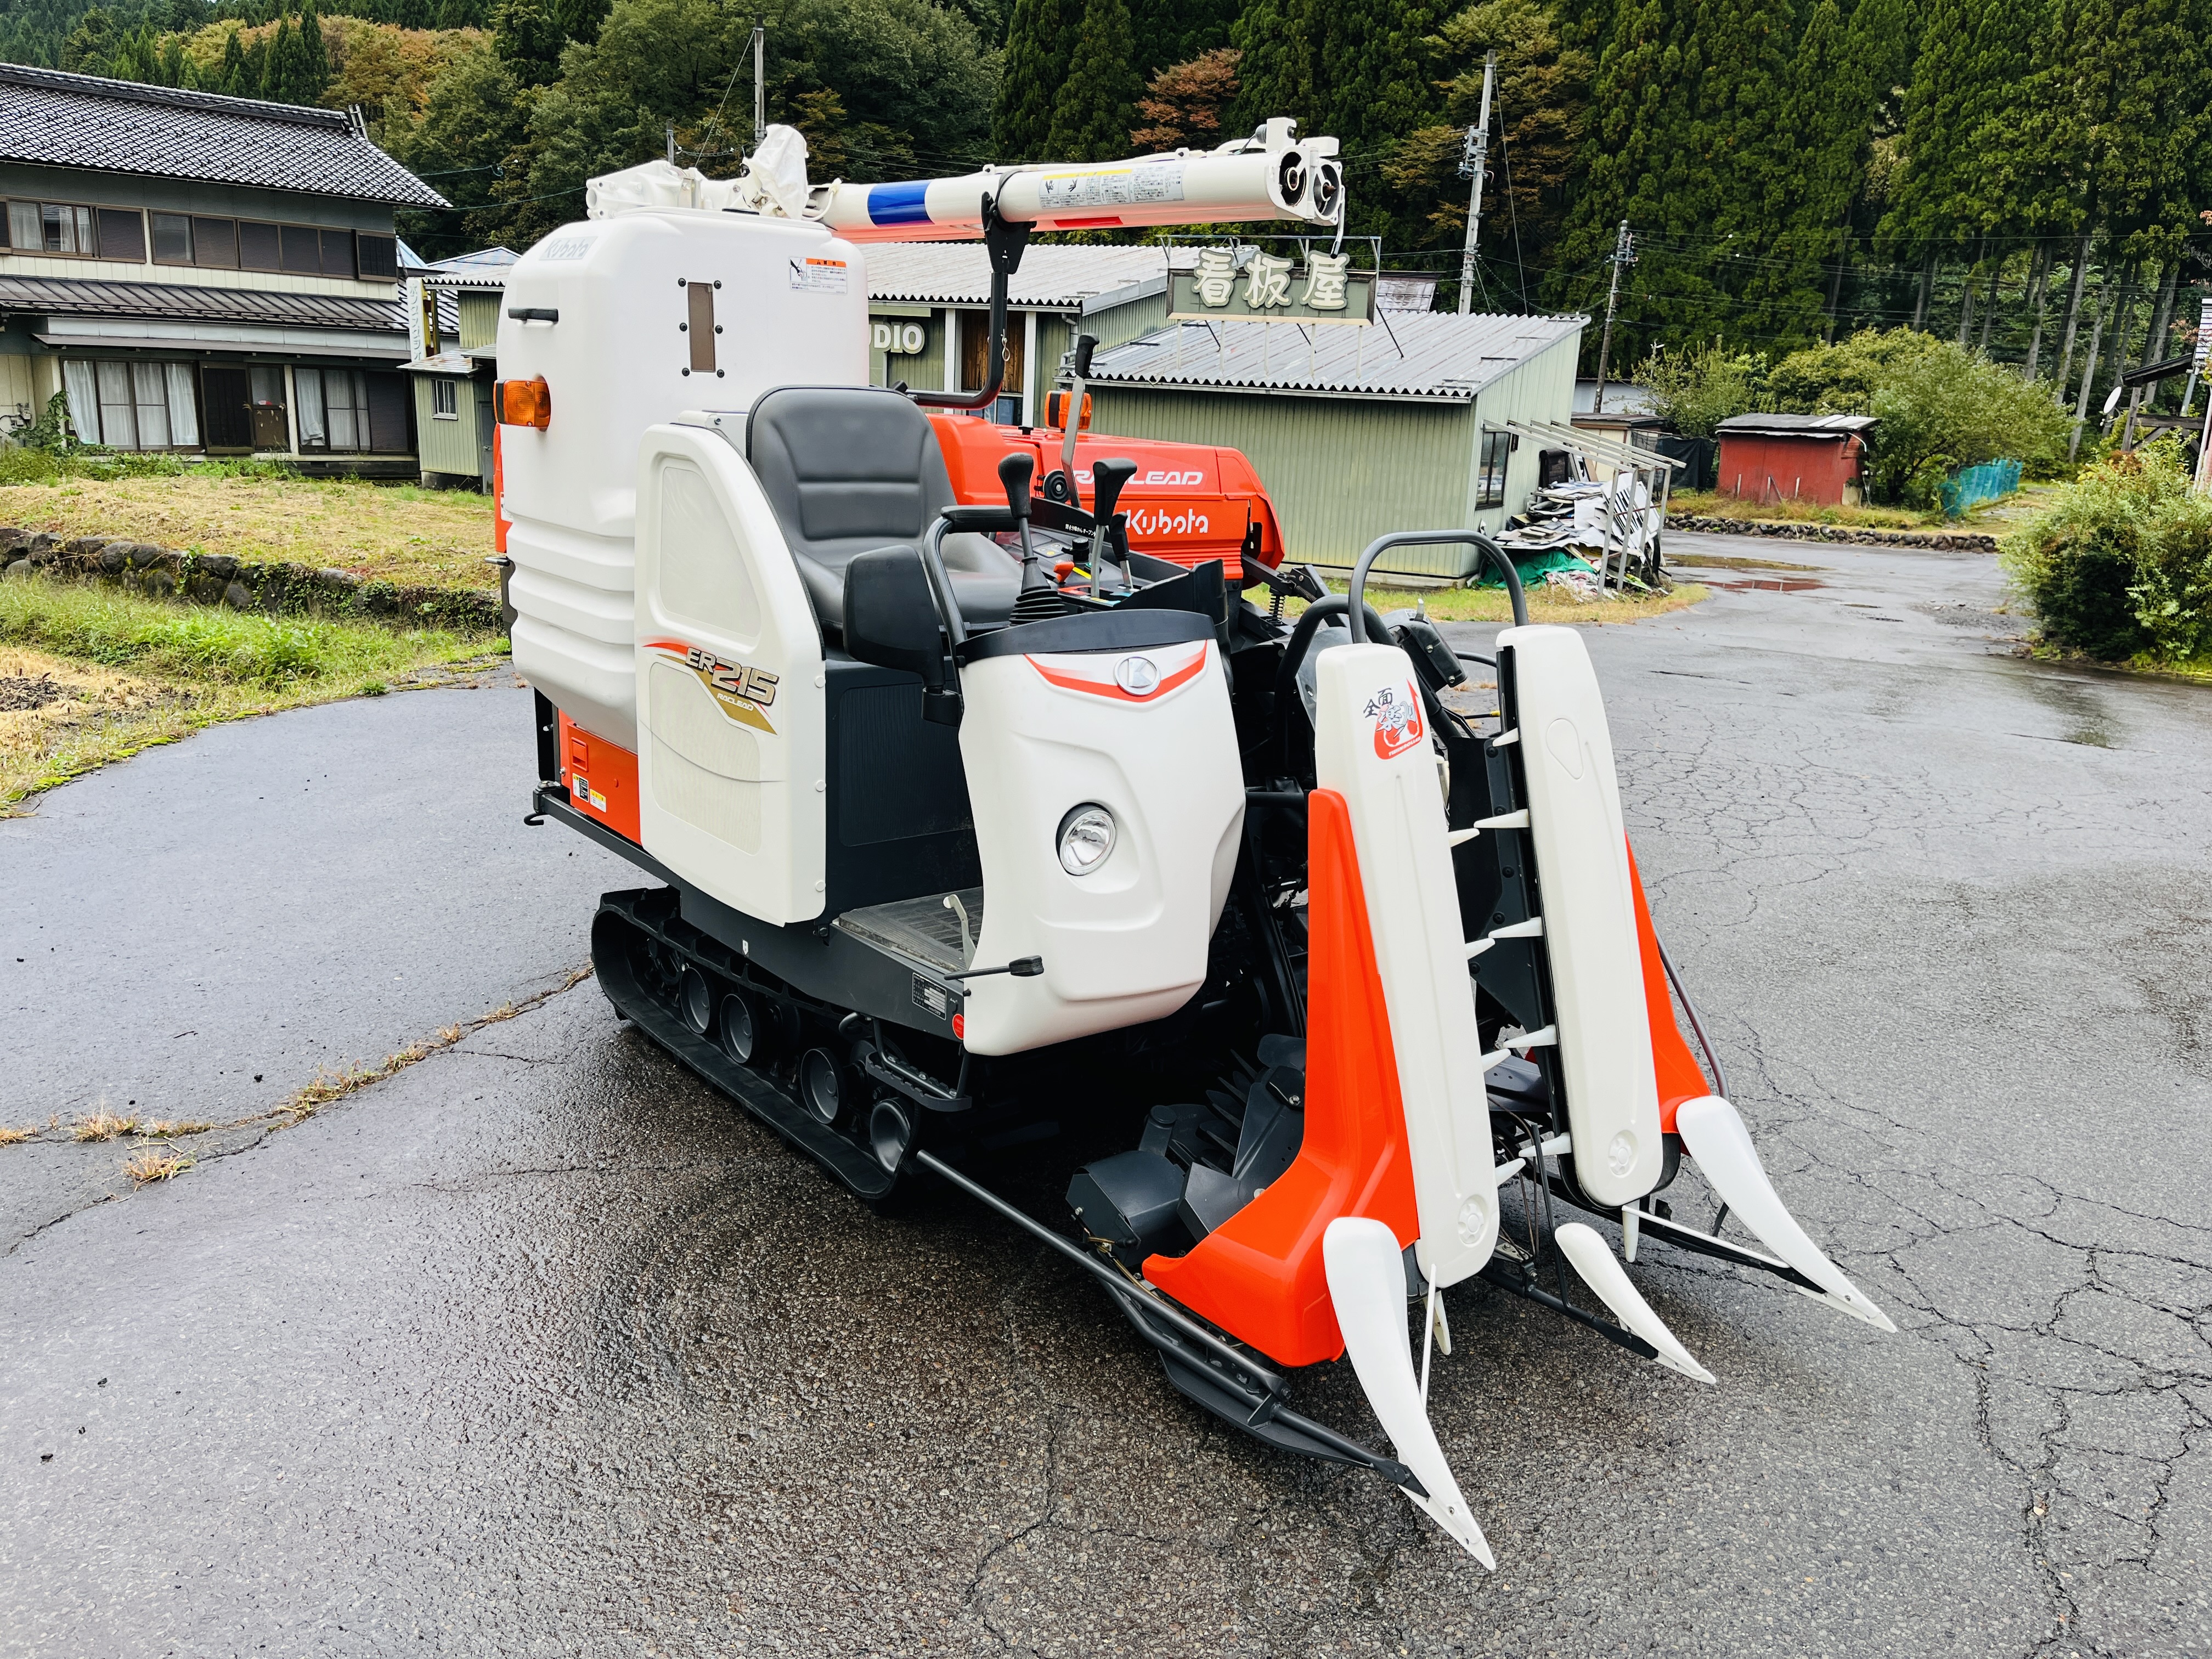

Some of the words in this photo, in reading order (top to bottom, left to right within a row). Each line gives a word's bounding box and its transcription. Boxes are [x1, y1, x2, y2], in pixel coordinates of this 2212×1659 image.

[544, 238, 589, 258] Kubota
[1193, 251, 1347, 307] 看板屋
[869, 324, 922, 351] DIO
[1073, 470, 1203, 486] RLEAD
[1125, 509, 1209, 535] Kubota
[685, 646, 780, 707] ER215
[716, 692, 754, 712] RACLEAD
